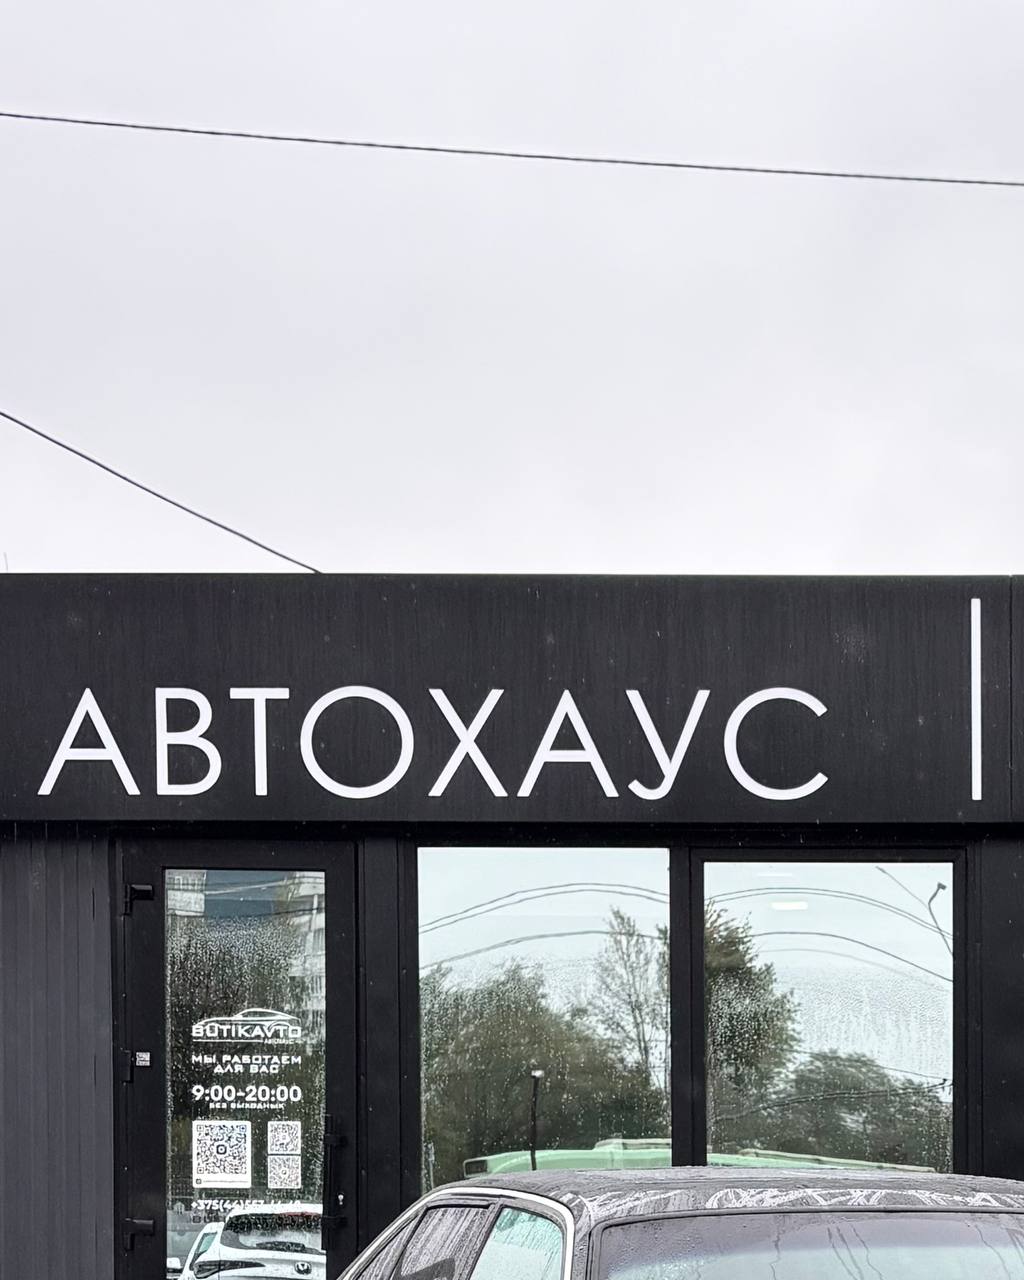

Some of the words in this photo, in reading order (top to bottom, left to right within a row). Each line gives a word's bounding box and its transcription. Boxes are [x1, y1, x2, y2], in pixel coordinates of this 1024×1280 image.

[37, 685, 829, 800] АВТОХАУС
[192, 1024, 302, 1038] BUTIKAVTO
[191, 1054, 216, 1064] МЫ
[222, 1054, 302, 1064] РАБОТАЕМ
[213, 1064, 243, 1073] ДЛЯ
[250, 1064, 280, 1073] ВАС
[192, 1085, 302, 1101] 9:00-20:00
